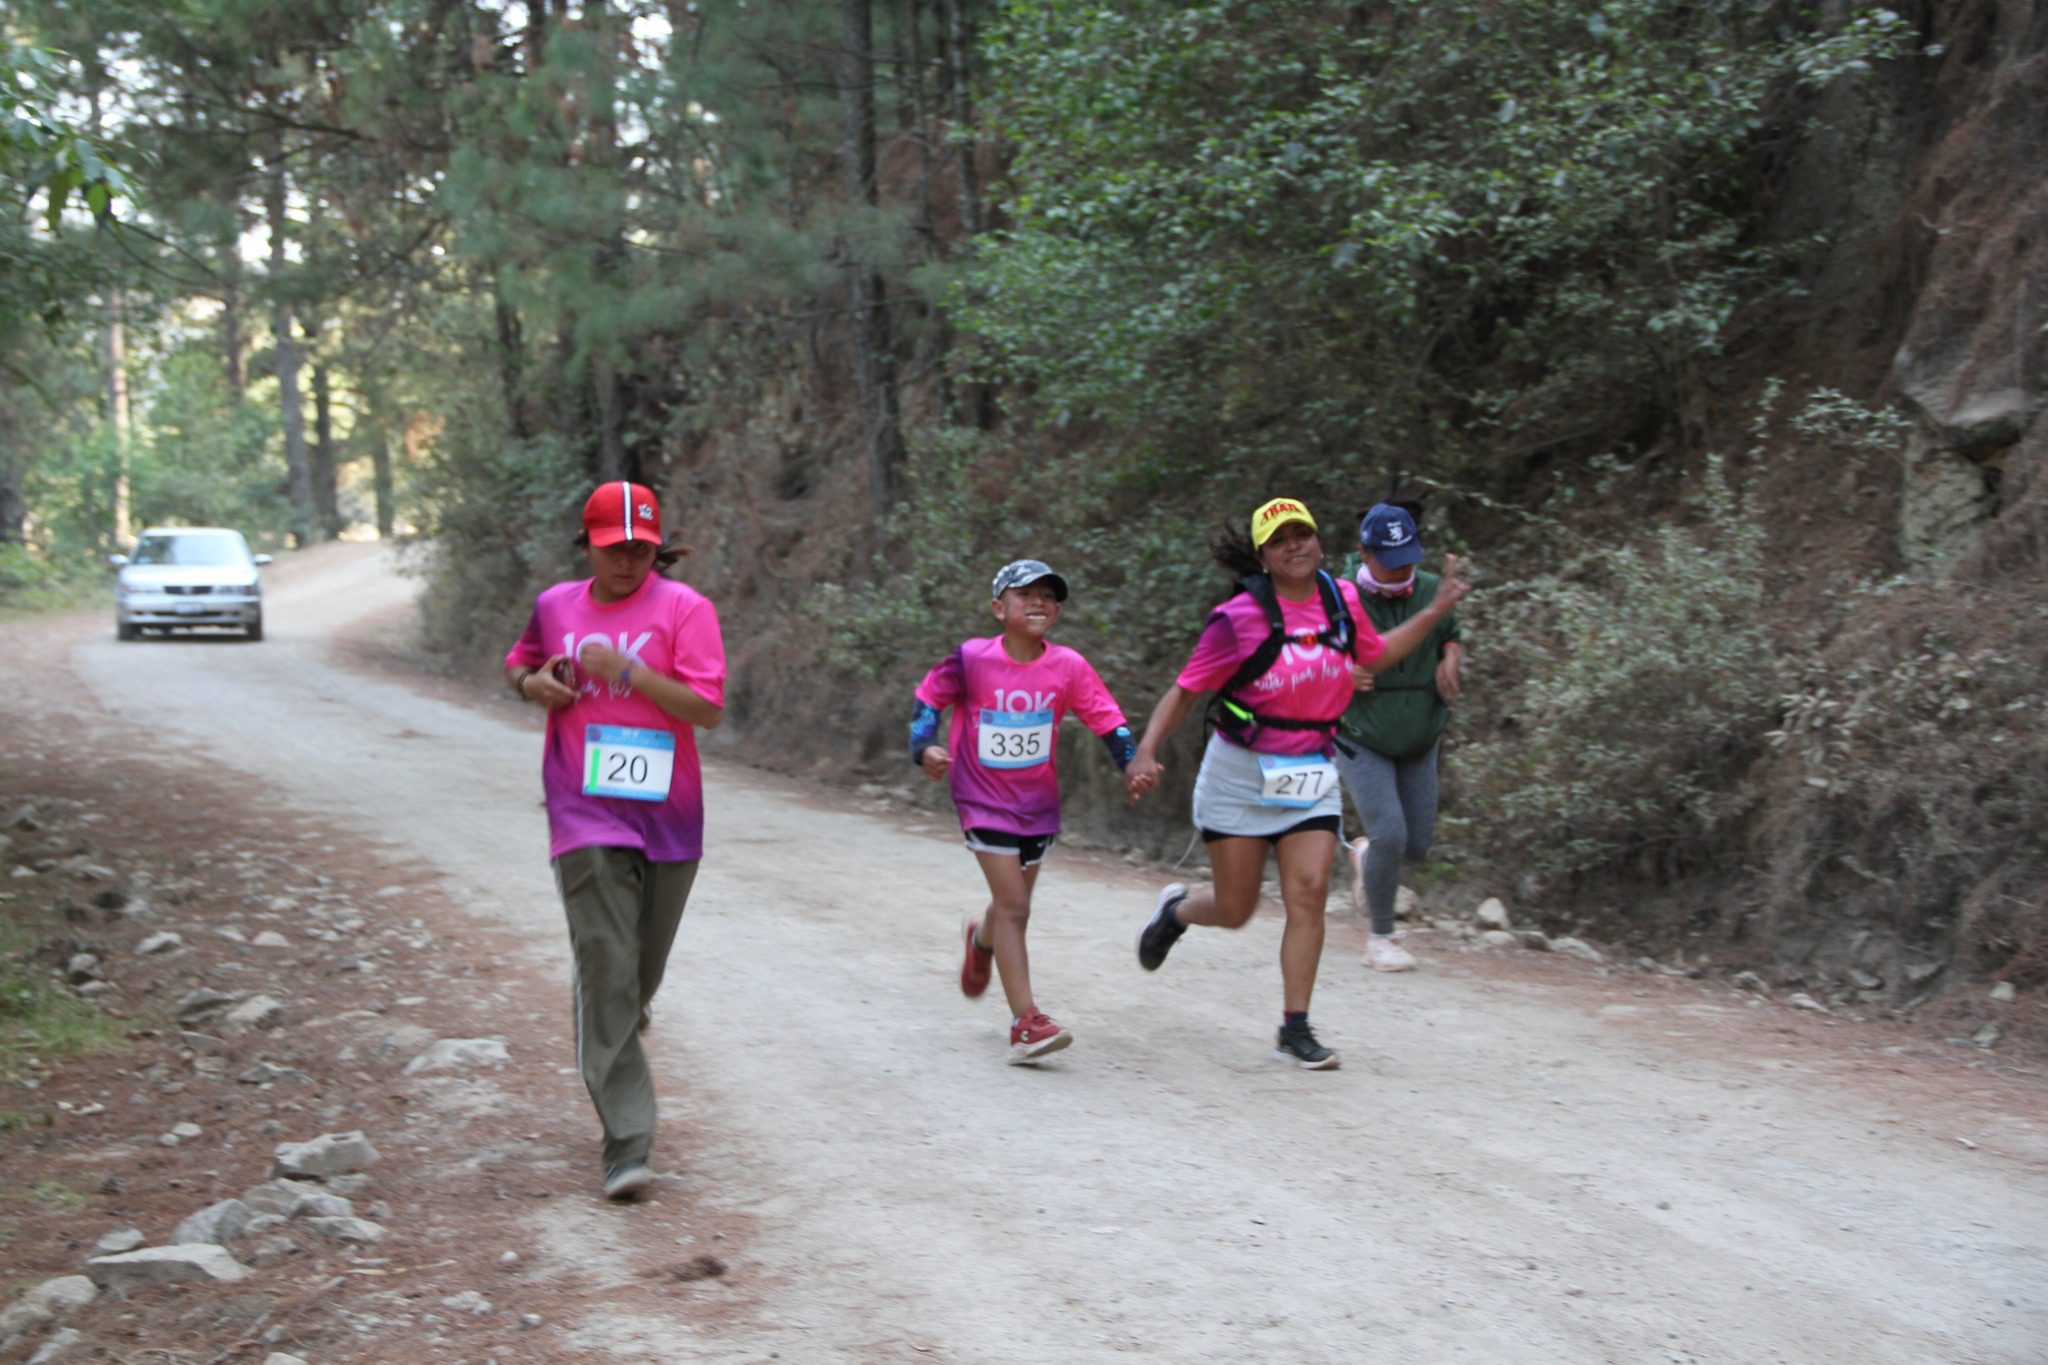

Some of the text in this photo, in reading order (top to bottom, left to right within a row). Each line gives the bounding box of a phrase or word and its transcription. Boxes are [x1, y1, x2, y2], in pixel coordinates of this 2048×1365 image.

[994, 689, 1056, 713] 10K
[990, 732, 1041, 757] 335
[607, 752, 649, 784] 20
[1275, 771, 1324, 796] 277
